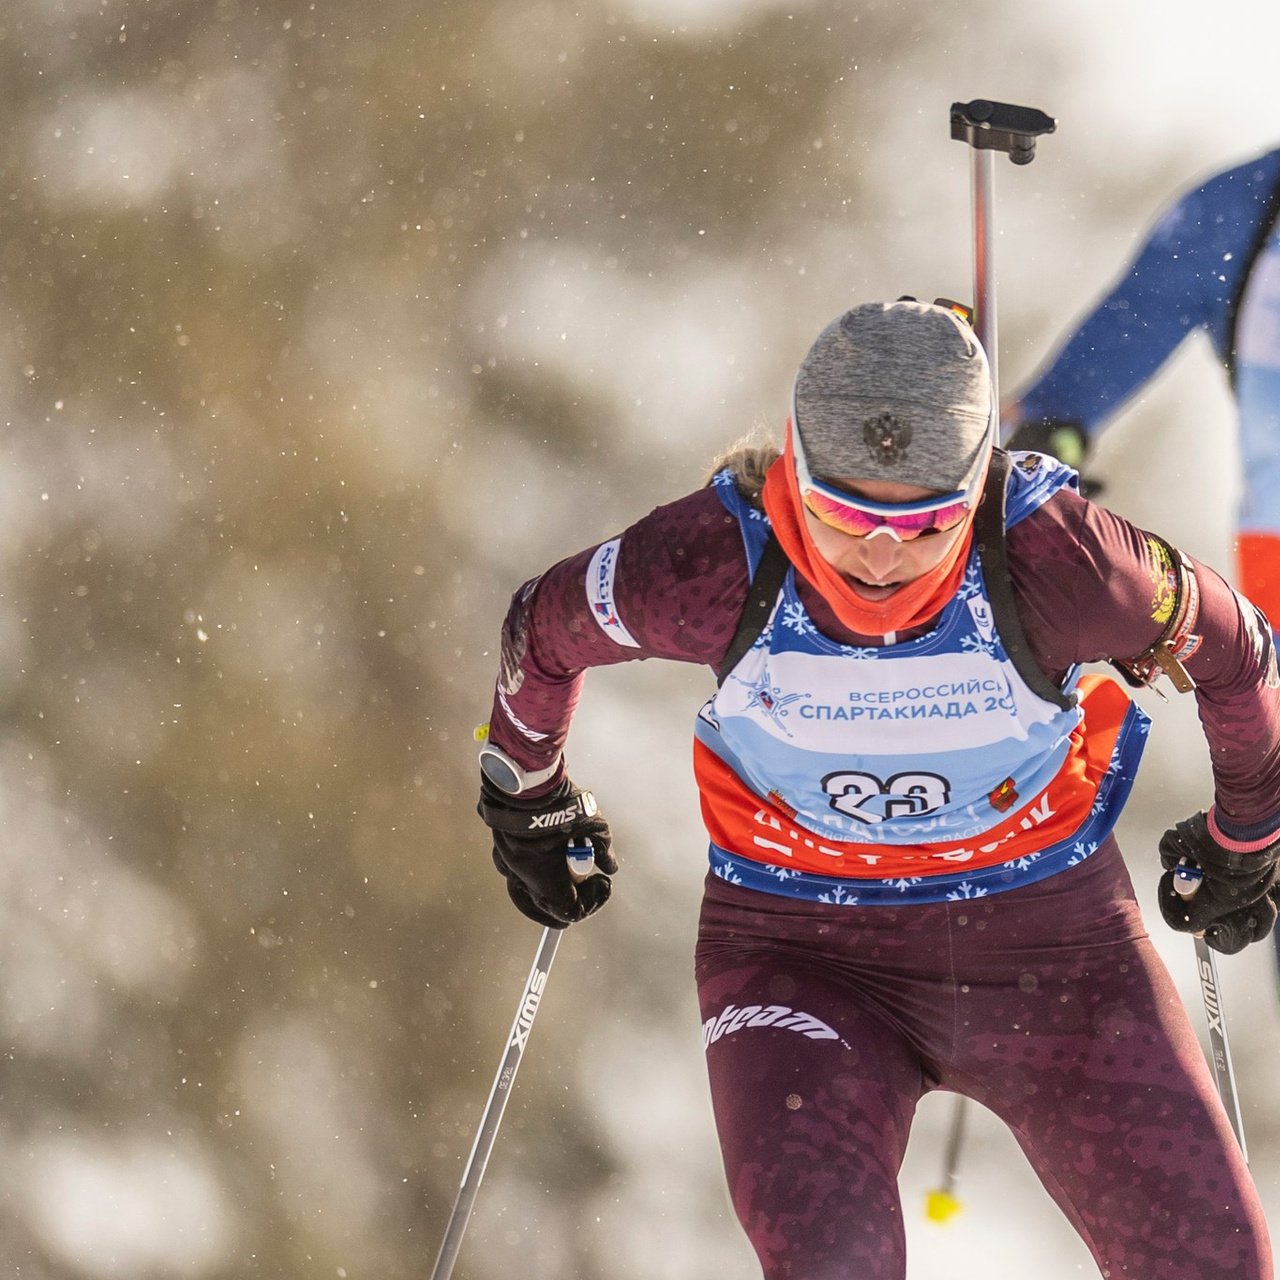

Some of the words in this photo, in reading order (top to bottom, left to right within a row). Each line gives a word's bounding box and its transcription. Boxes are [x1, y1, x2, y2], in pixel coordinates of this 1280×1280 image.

[799, 701, 978, 721] СПАРТАКИАДА
[820, 770, 951, 825] 23
[510, 967, 547, 1053] SWIX
[1197, 956, 1223, 1037] SWIX
